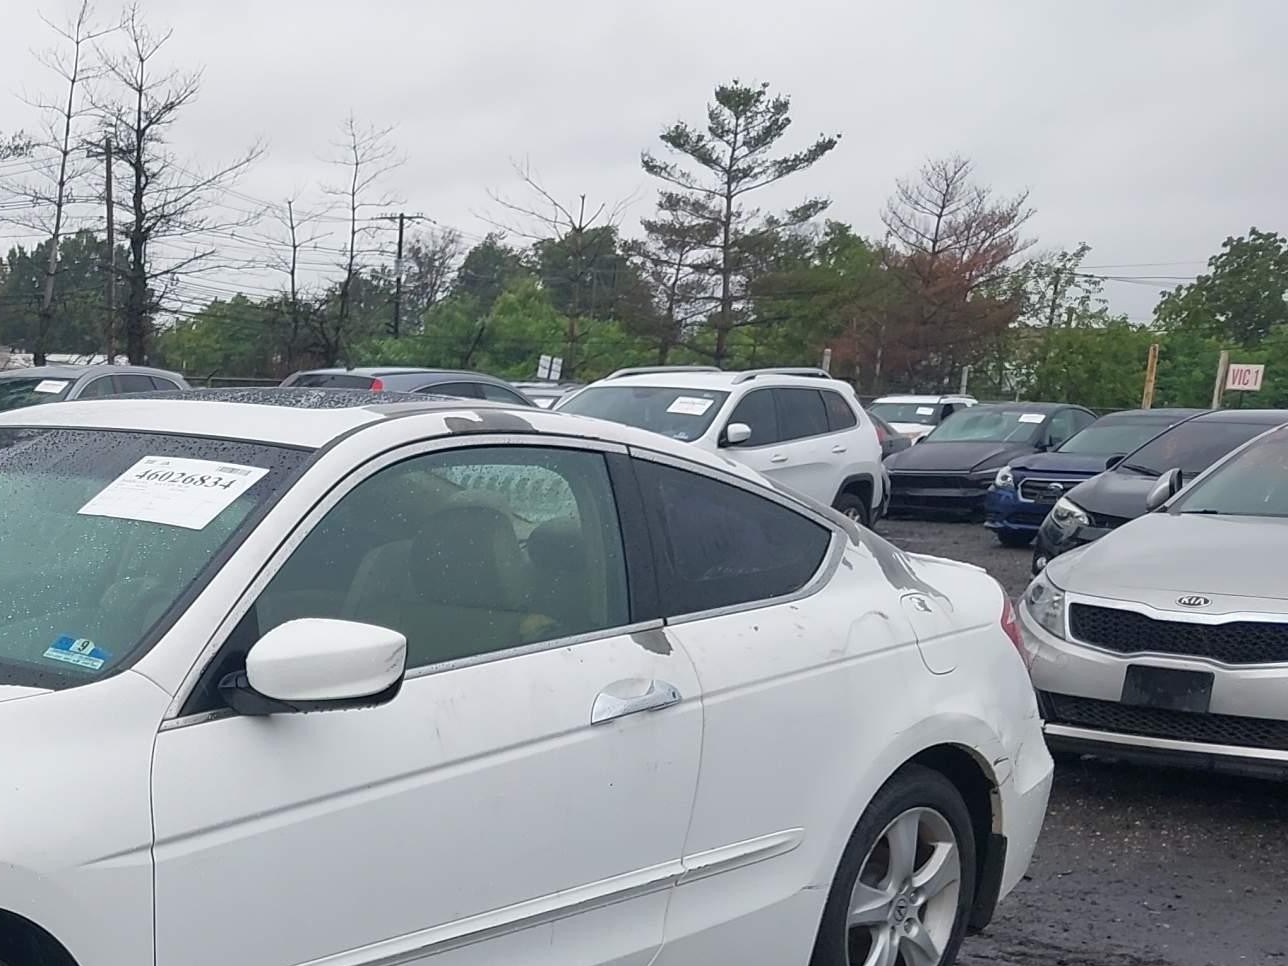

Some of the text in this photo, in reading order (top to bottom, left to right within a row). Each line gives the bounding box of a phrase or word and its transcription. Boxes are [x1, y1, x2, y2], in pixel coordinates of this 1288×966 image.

[1232, 368, 1260, 386] VIC 1
[135, 469, 237, 491] 46026834
[78, 640, 90, 652] 9
